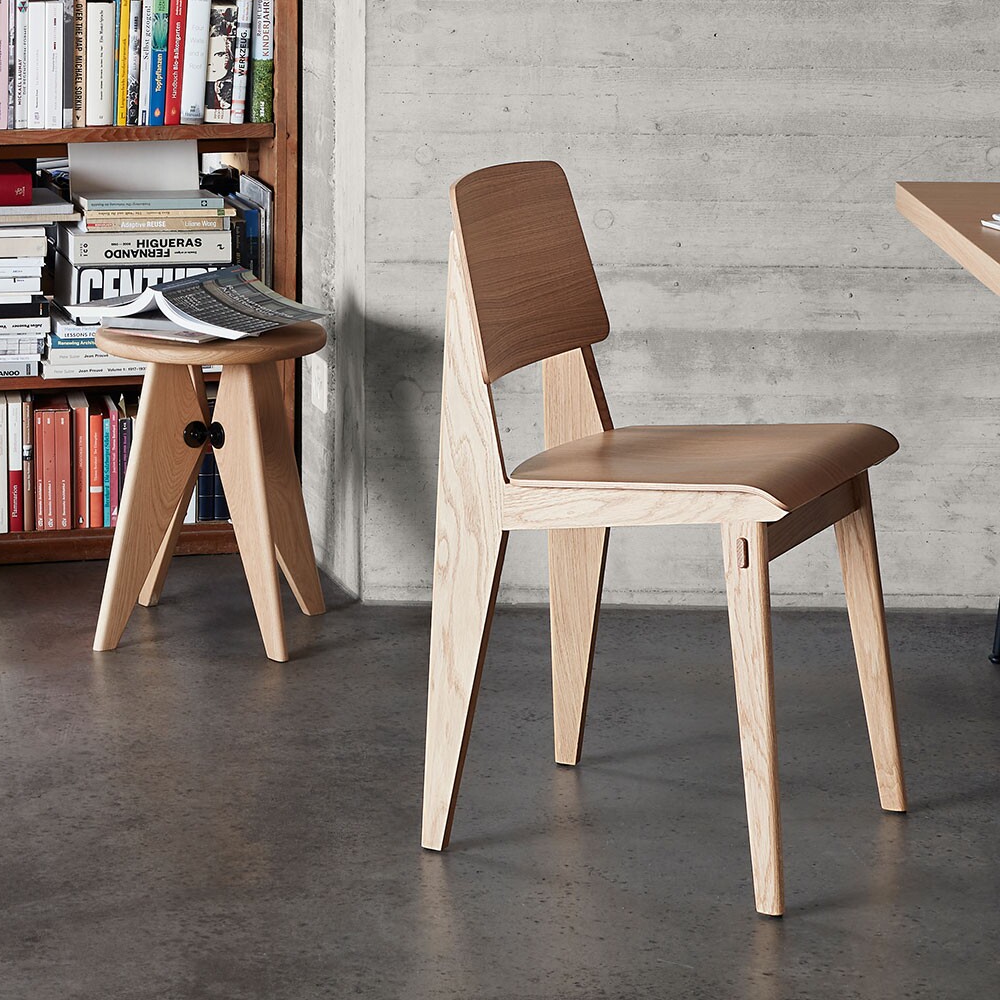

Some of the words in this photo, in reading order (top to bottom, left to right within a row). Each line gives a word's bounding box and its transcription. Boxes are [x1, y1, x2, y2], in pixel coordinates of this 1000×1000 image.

[75, 3, 83, 21] OVER
[144, 5, 152, 37] gezogen!
[142, 38, 150, 60] Selbst
[173, 21, 181, 71] Bio-Balkongarten
[238, 30, 248, 77] WERKZEUG.
[155, 53, 163, 92] Topfpflanzen
[104, 248, 170, 258] FERNANDO
[136, 238, 202, 248] HIGUERAS
